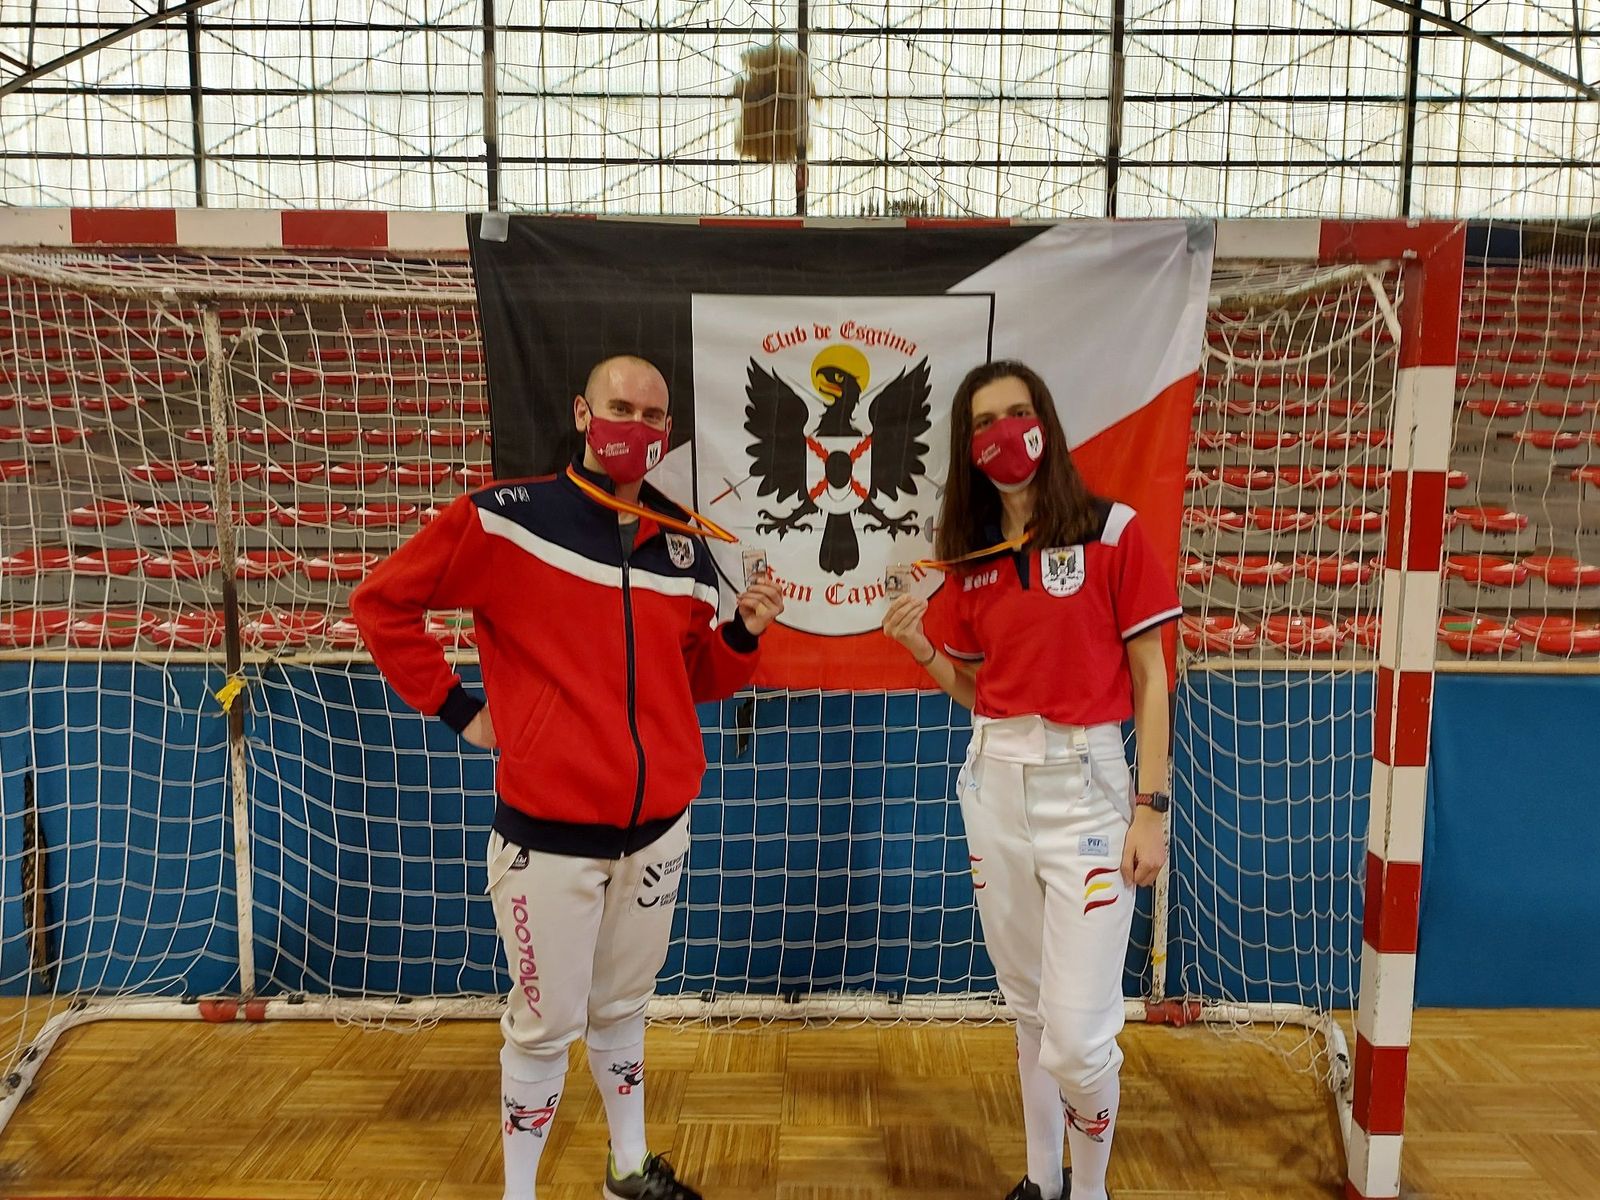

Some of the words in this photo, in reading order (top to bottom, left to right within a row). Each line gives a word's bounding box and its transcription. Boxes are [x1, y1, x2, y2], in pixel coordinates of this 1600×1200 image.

[762, 324, 807, 354] Club
[813, 321, 831, 340] de
[839, 319, 918, 357] Esgrima
